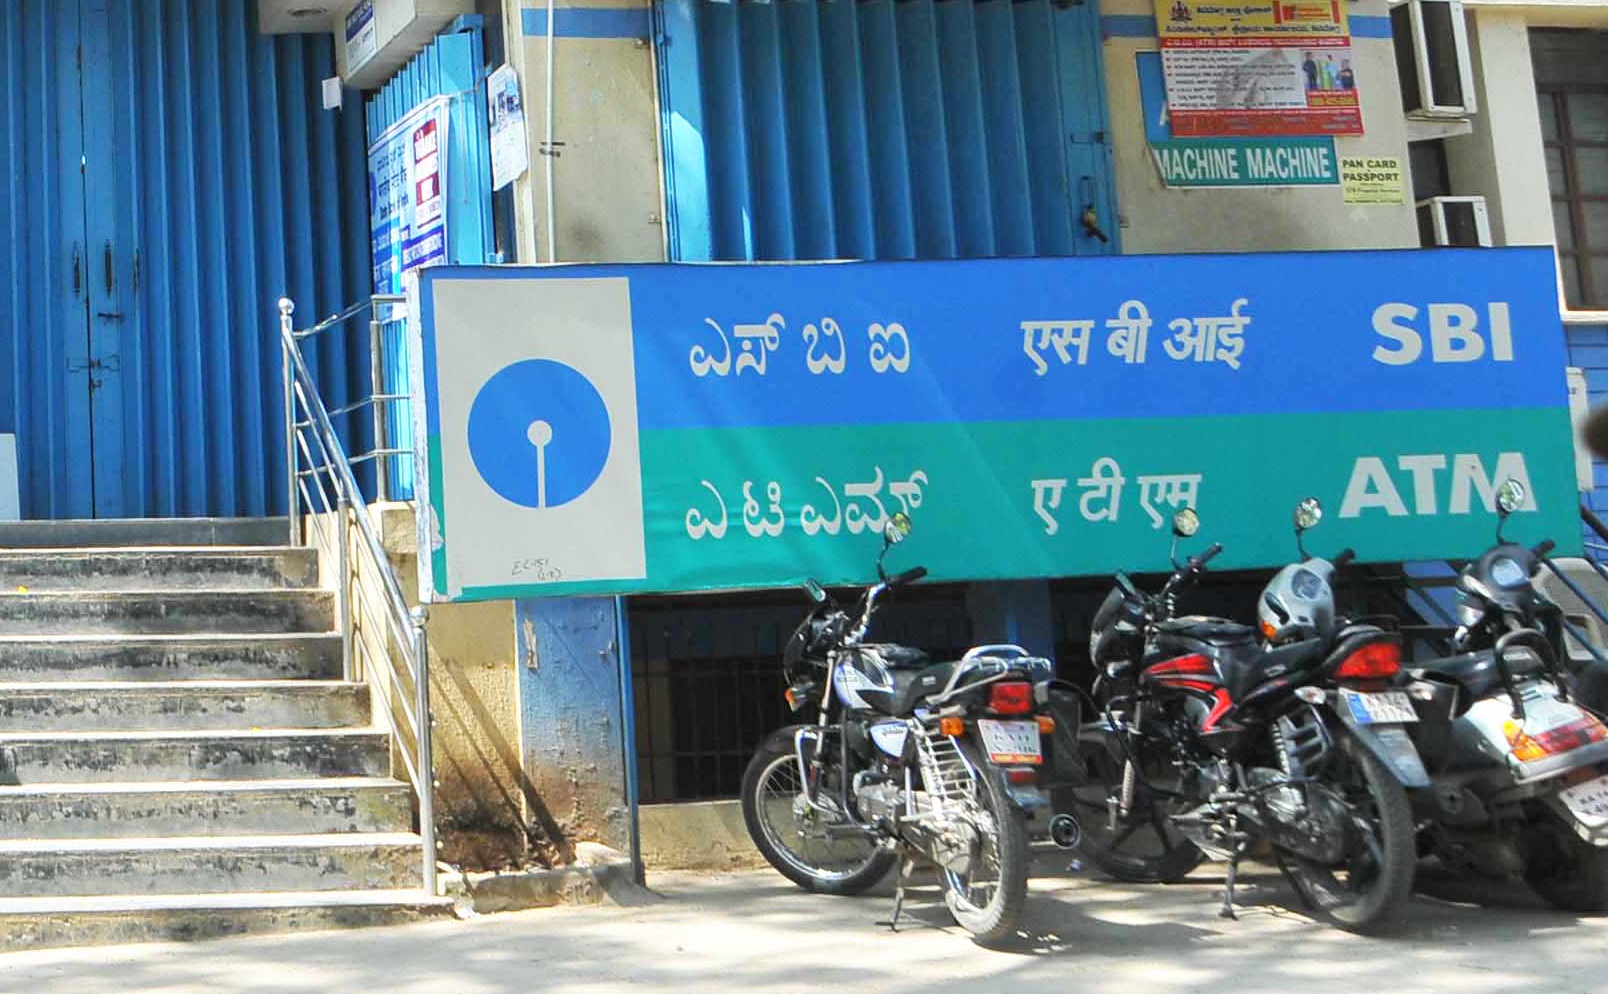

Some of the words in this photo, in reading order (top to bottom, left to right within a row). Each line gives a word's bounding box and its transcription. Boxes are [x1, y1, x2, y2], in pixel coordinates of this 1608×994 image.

[1154, 148, 1240, 179] MACHINE
[1244, 147, 1332, 179] MACHINE
[1342, 159, 1364, 168] PAN
[1366, 159, 1397, 168] CARD
[1343, 172, 1400, 182] PASSPORT
[689, 312, 787, 377] ಎಸ್
[802, 316, 847, 375] ಬಿ
[868, 322, 911, 374] ಐ
[1020, 319, 1096, 377] एस
[1105, 299, 1153, 365] बी
[1162, 298, 1252, 371] आई
[1371, 301, 1514, 366] SBI
[685, 479, 729, 541] ಎ
[743, 480, 785, 538] ಟಿ
[1031, 478, 1067, 536] ए
[1077, 456, 1126, 523] टी
[1136, 473, 1203, 530] एम
[1338, 451, 1539, 519] ATM
